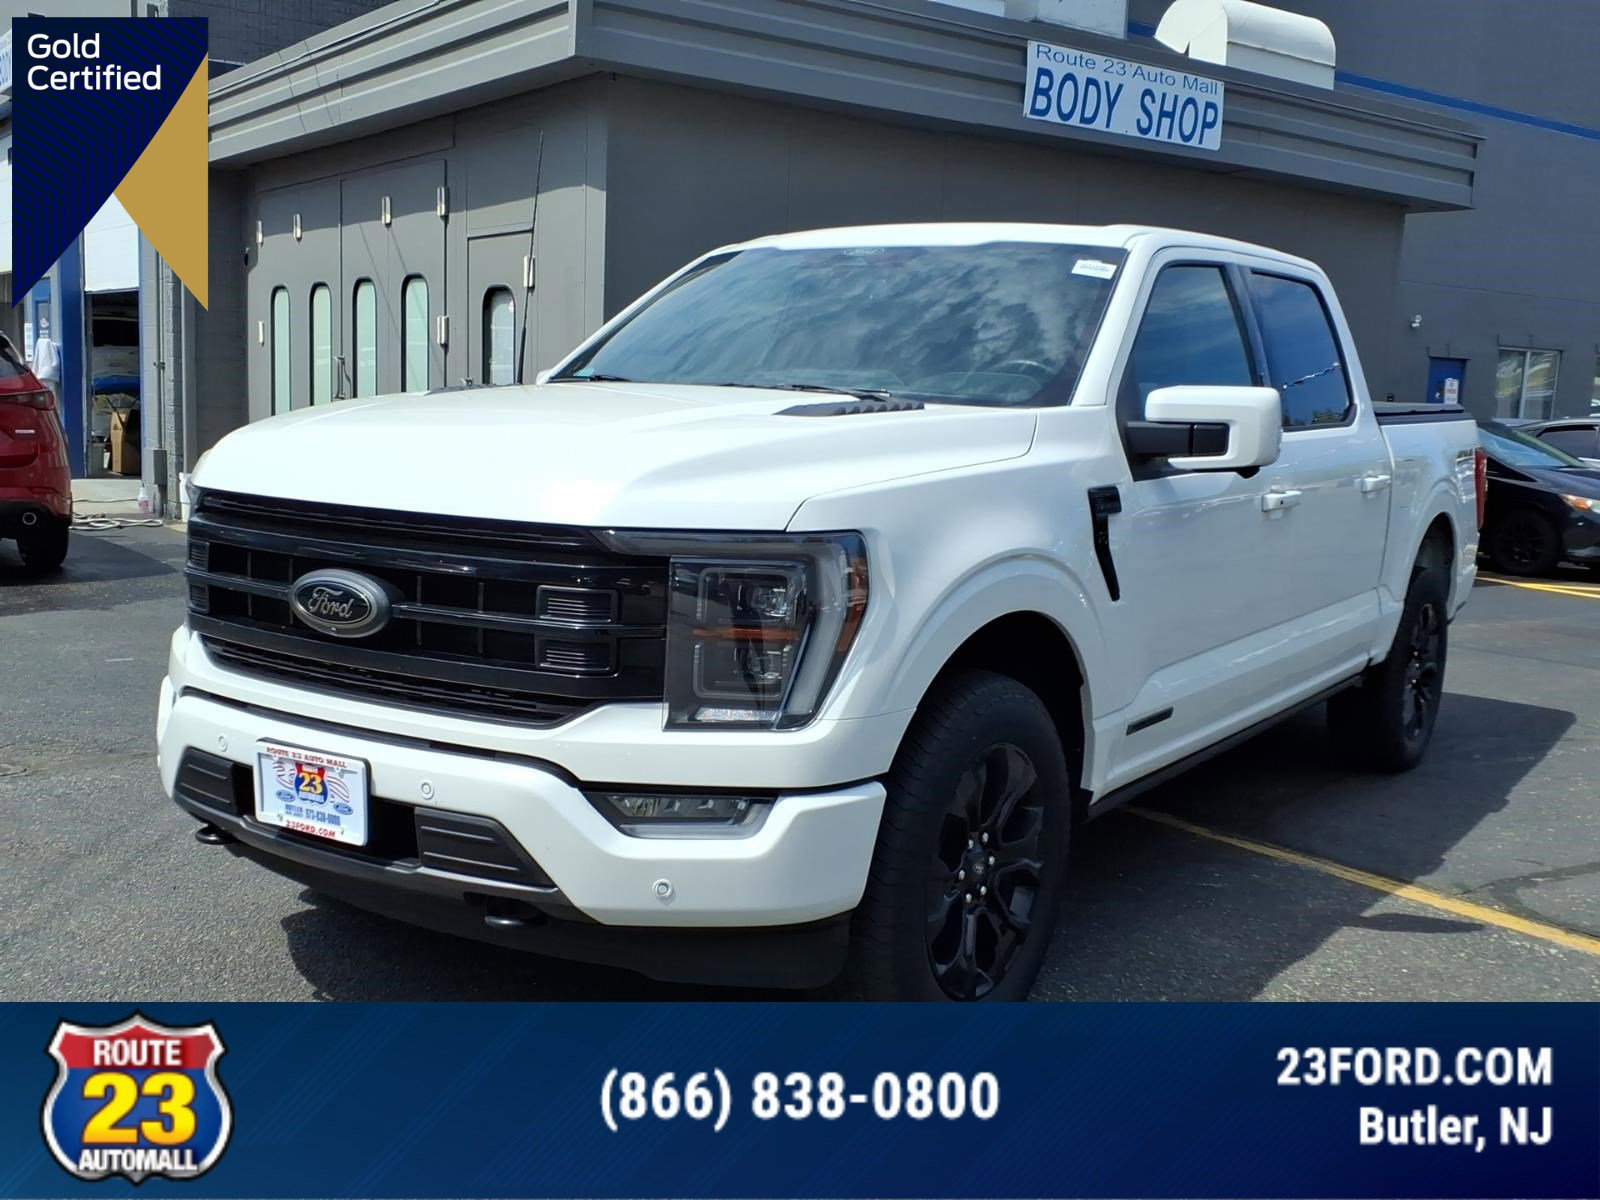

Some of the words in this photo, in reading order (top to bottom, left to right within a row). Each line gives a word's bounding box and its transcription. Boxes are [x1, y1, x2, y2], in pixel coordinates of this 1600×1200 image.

[1036, 44, 1097, 70] Route
[1103, 58, 1127, 76] 23
[1132, 65, 1176, 86] Auto
[1183, 74, 1218, 95] Mall
[1029, 67, 1124, 129] BODY
[1136, 88, 1219, 145] SHOP
[308, 586, 354, 618] Ford
[266, 747, 289, 757] ROUTE
[304, 754, 325, 763] AUTO
[326, 758, 347, 769] MALL
[298, 772, 323, 794] 23
[286, 820, 336, 837] 23FORD.COM
